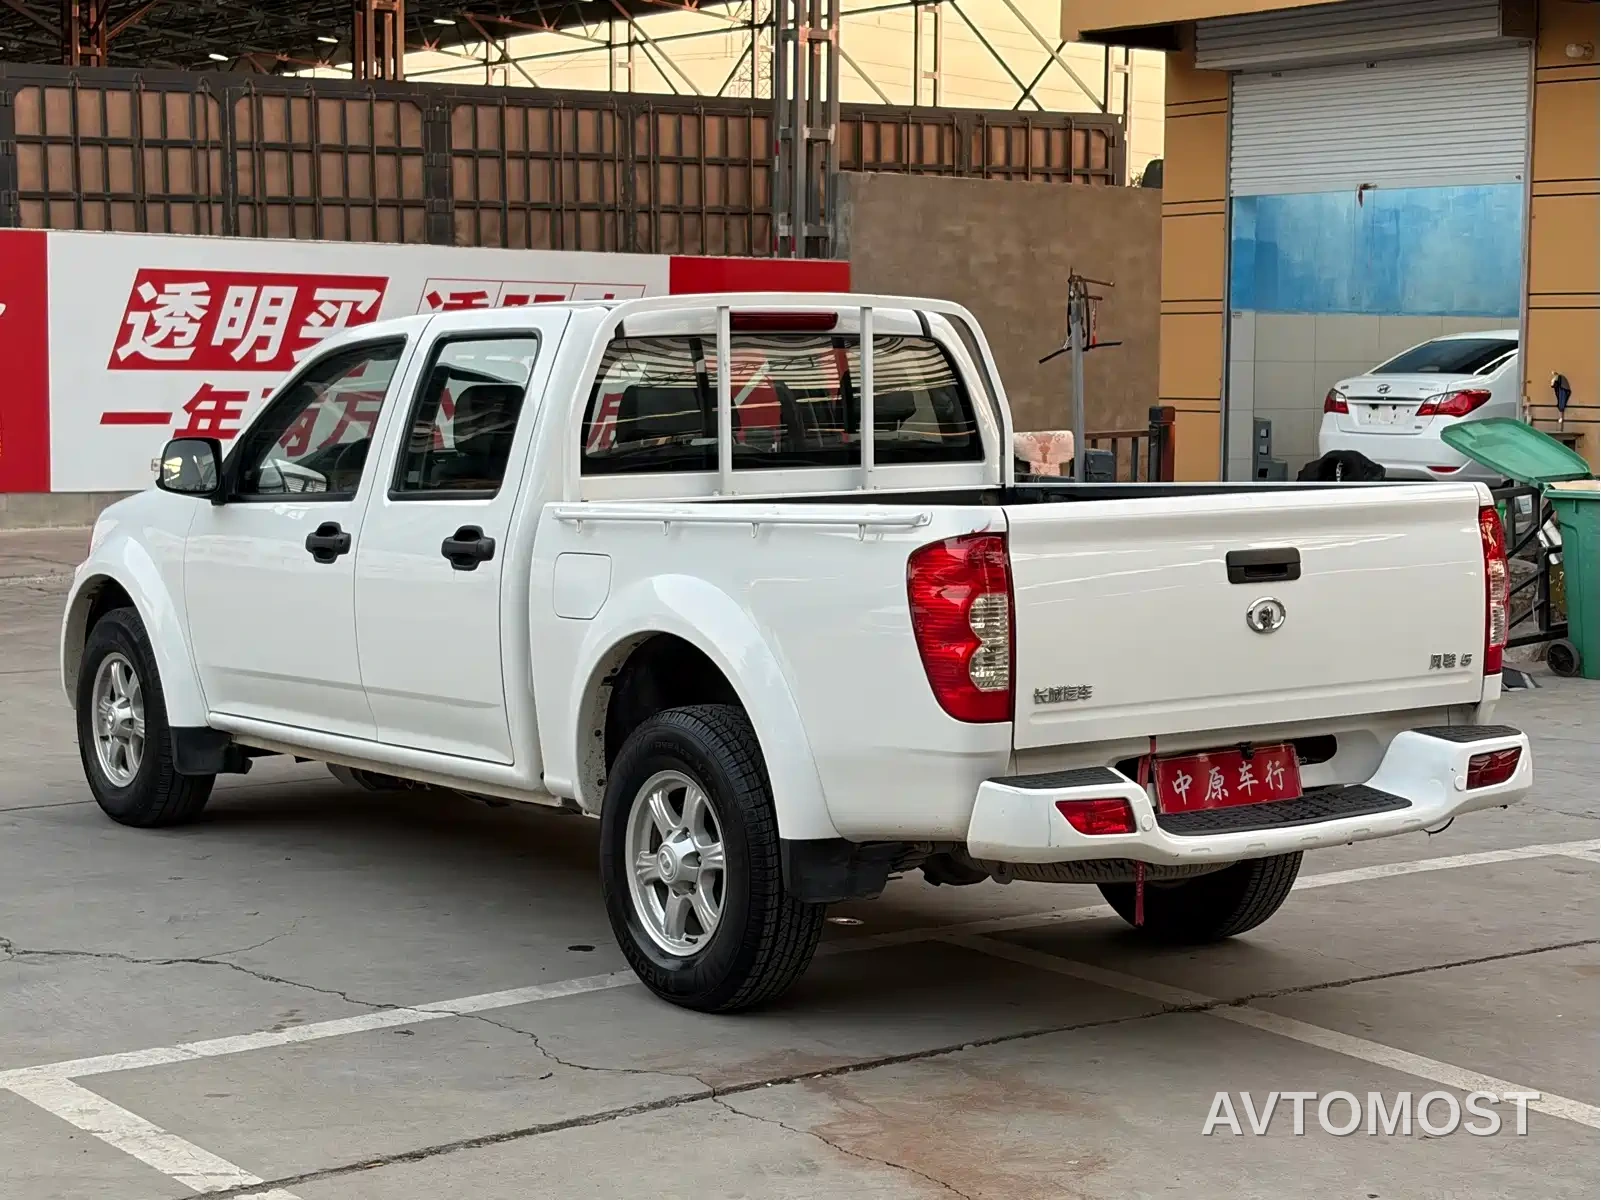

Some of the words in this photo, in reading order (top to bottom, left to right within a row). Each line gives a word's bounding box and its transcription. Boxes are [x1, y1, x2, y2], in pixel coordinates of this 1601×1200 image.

[1460, 653, 1473, 667] 5
[1033, 684, 1093, 705] 长城汽车
[1172, 760, 1285, 805] 中原车行
